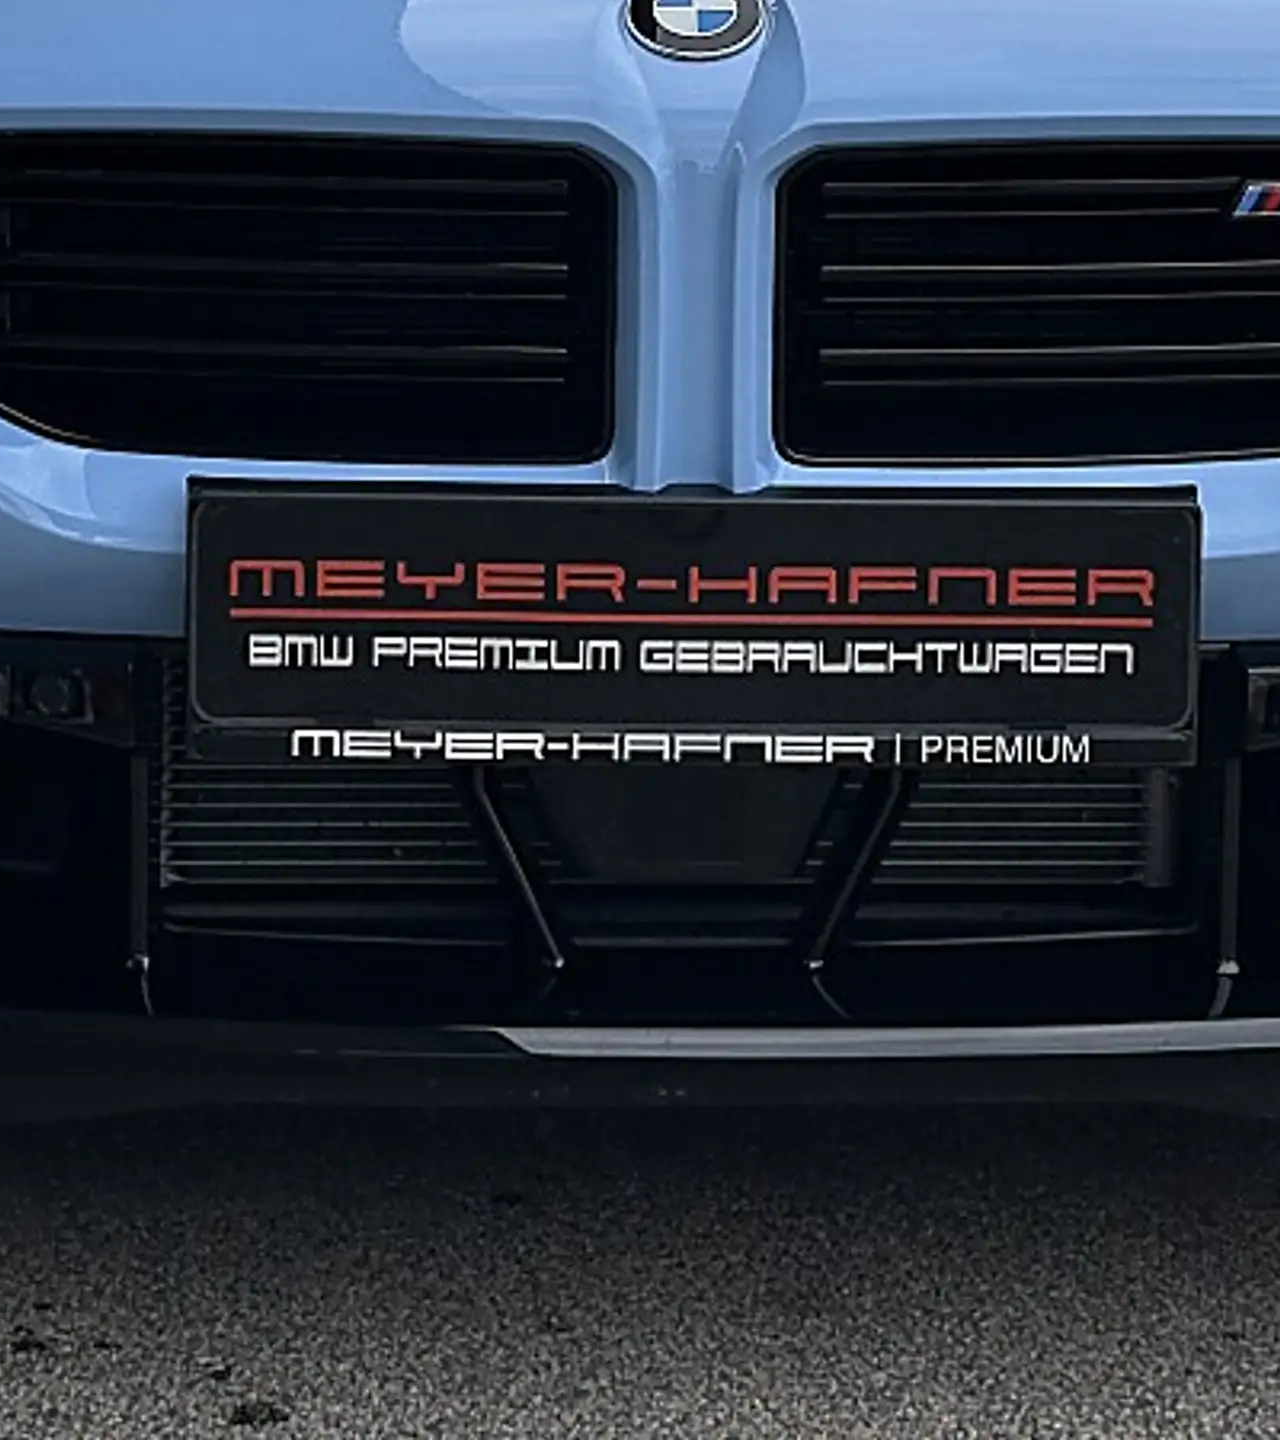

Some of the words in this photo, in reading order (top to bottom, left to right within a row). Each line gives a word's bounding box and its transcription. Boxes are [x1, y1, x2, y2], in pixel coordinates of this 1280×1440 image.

[229, 560, 1153, 605] MEYER-HAFNER
[249, 634, 354, 667] BMW
[373, 636, 621, 671] PREMIUM
[639, 640, 1134, 674] GEBRAUCHTWAGEN
[291, 729, 875, 764] MEYER-HAFNER
[921, 735, 1091, 765] PREMIUM
